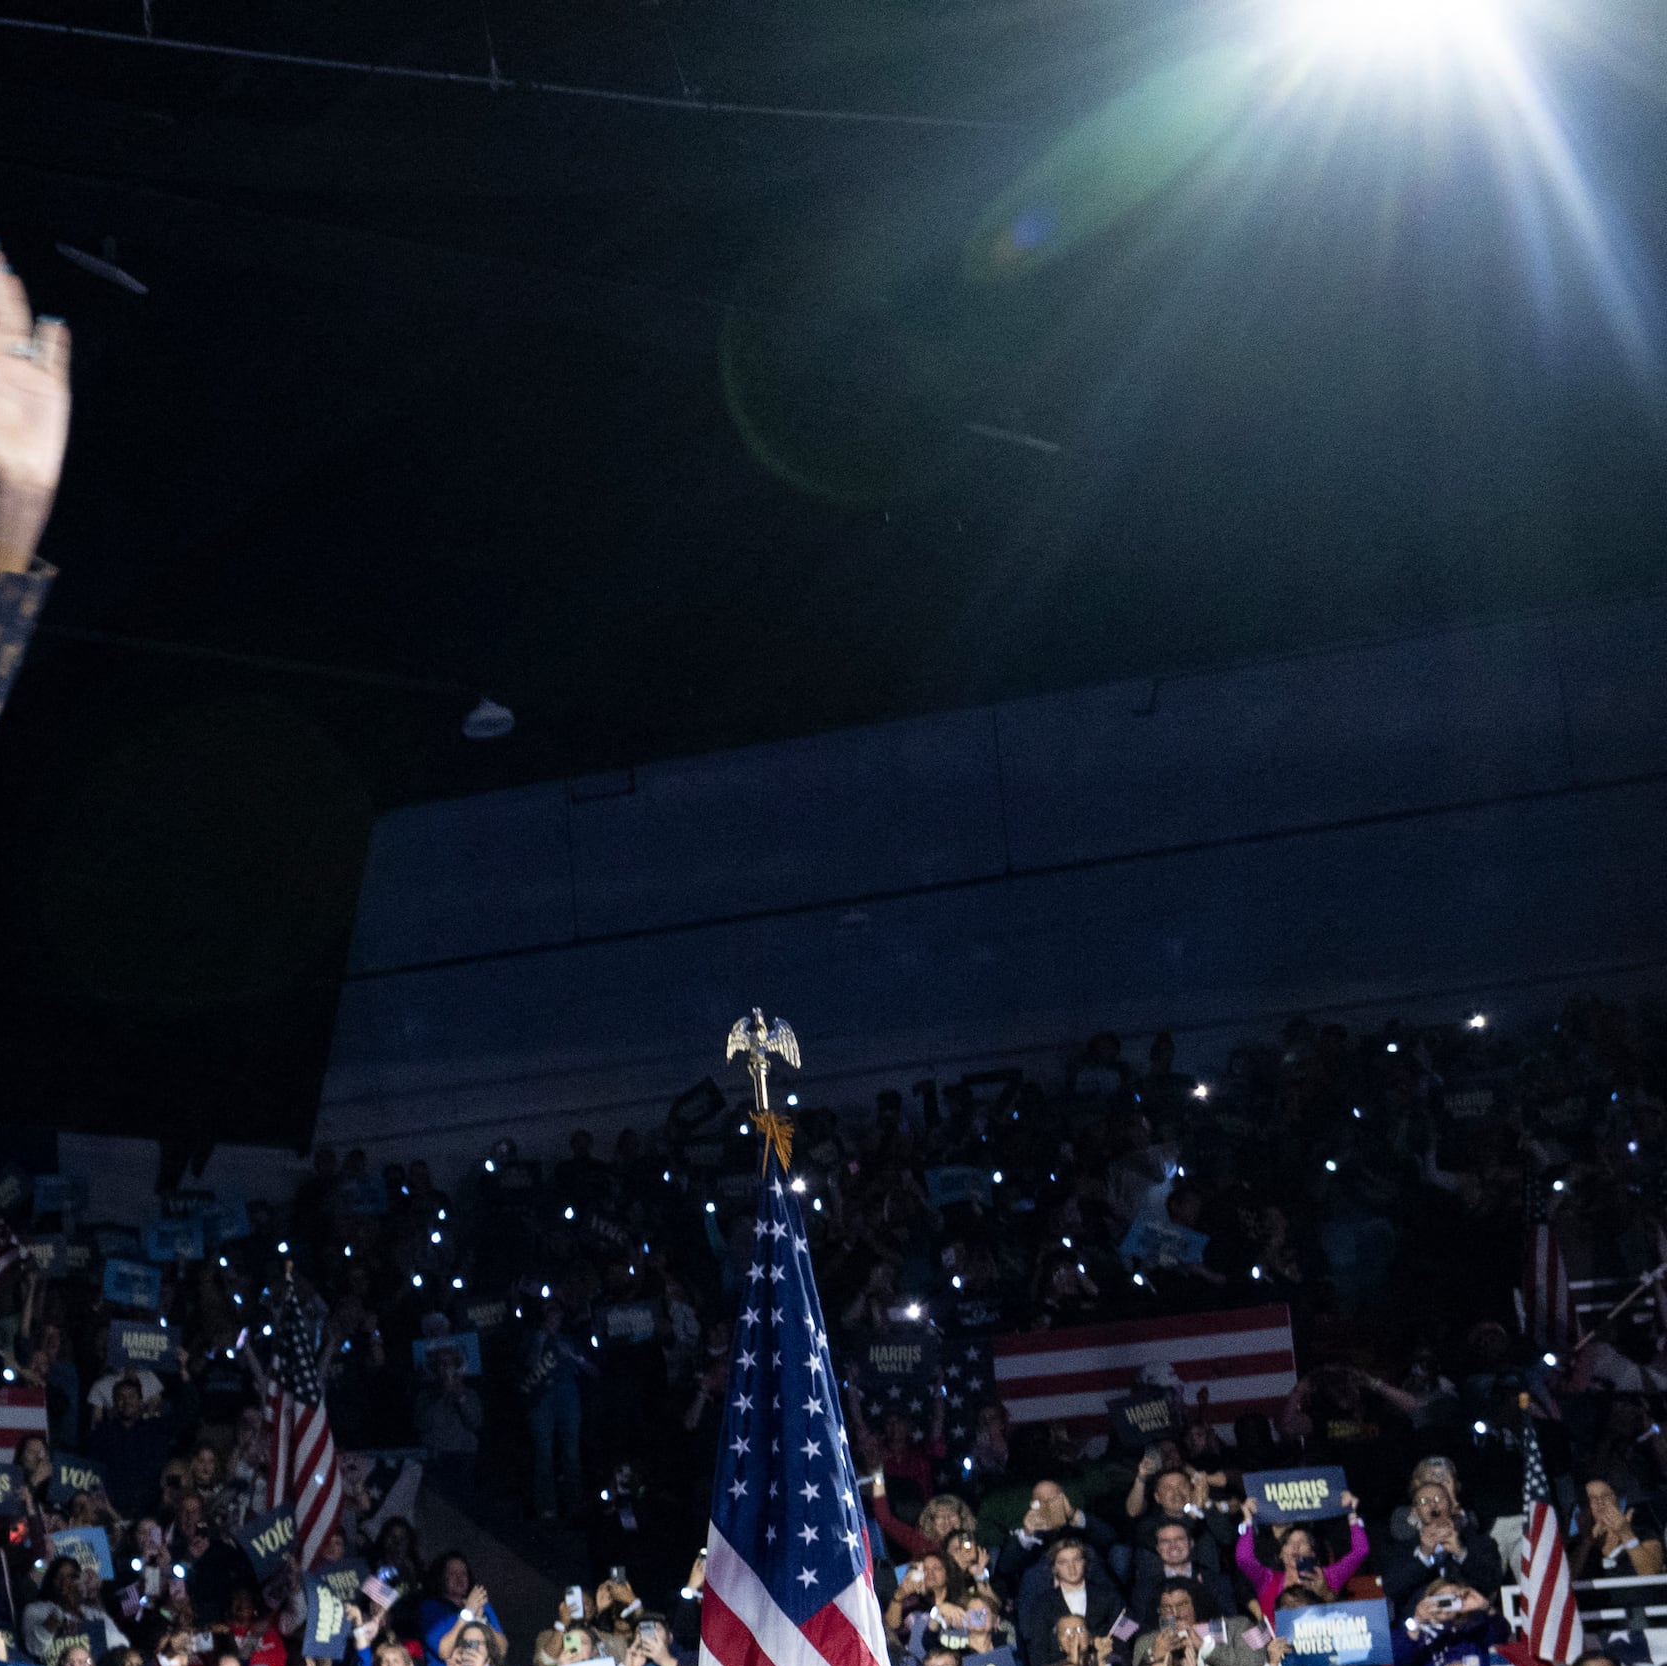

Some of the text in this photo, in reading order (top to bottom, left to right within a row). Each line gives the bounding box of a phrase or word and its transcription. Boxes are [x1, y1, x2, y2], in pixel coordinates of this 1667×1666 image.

[869, 1343, 922, 1364] HARRIS
[1264, 1478, 1329, 1503] HARRIS
[1277, 1497, 1322, 1512] WALZ
[250, 1514, 295, 1556] vote
[1293, 1616, 1368, 1636] MICHIGAN
[1293, 1631, 1372, 1654] VOTES EARLY
